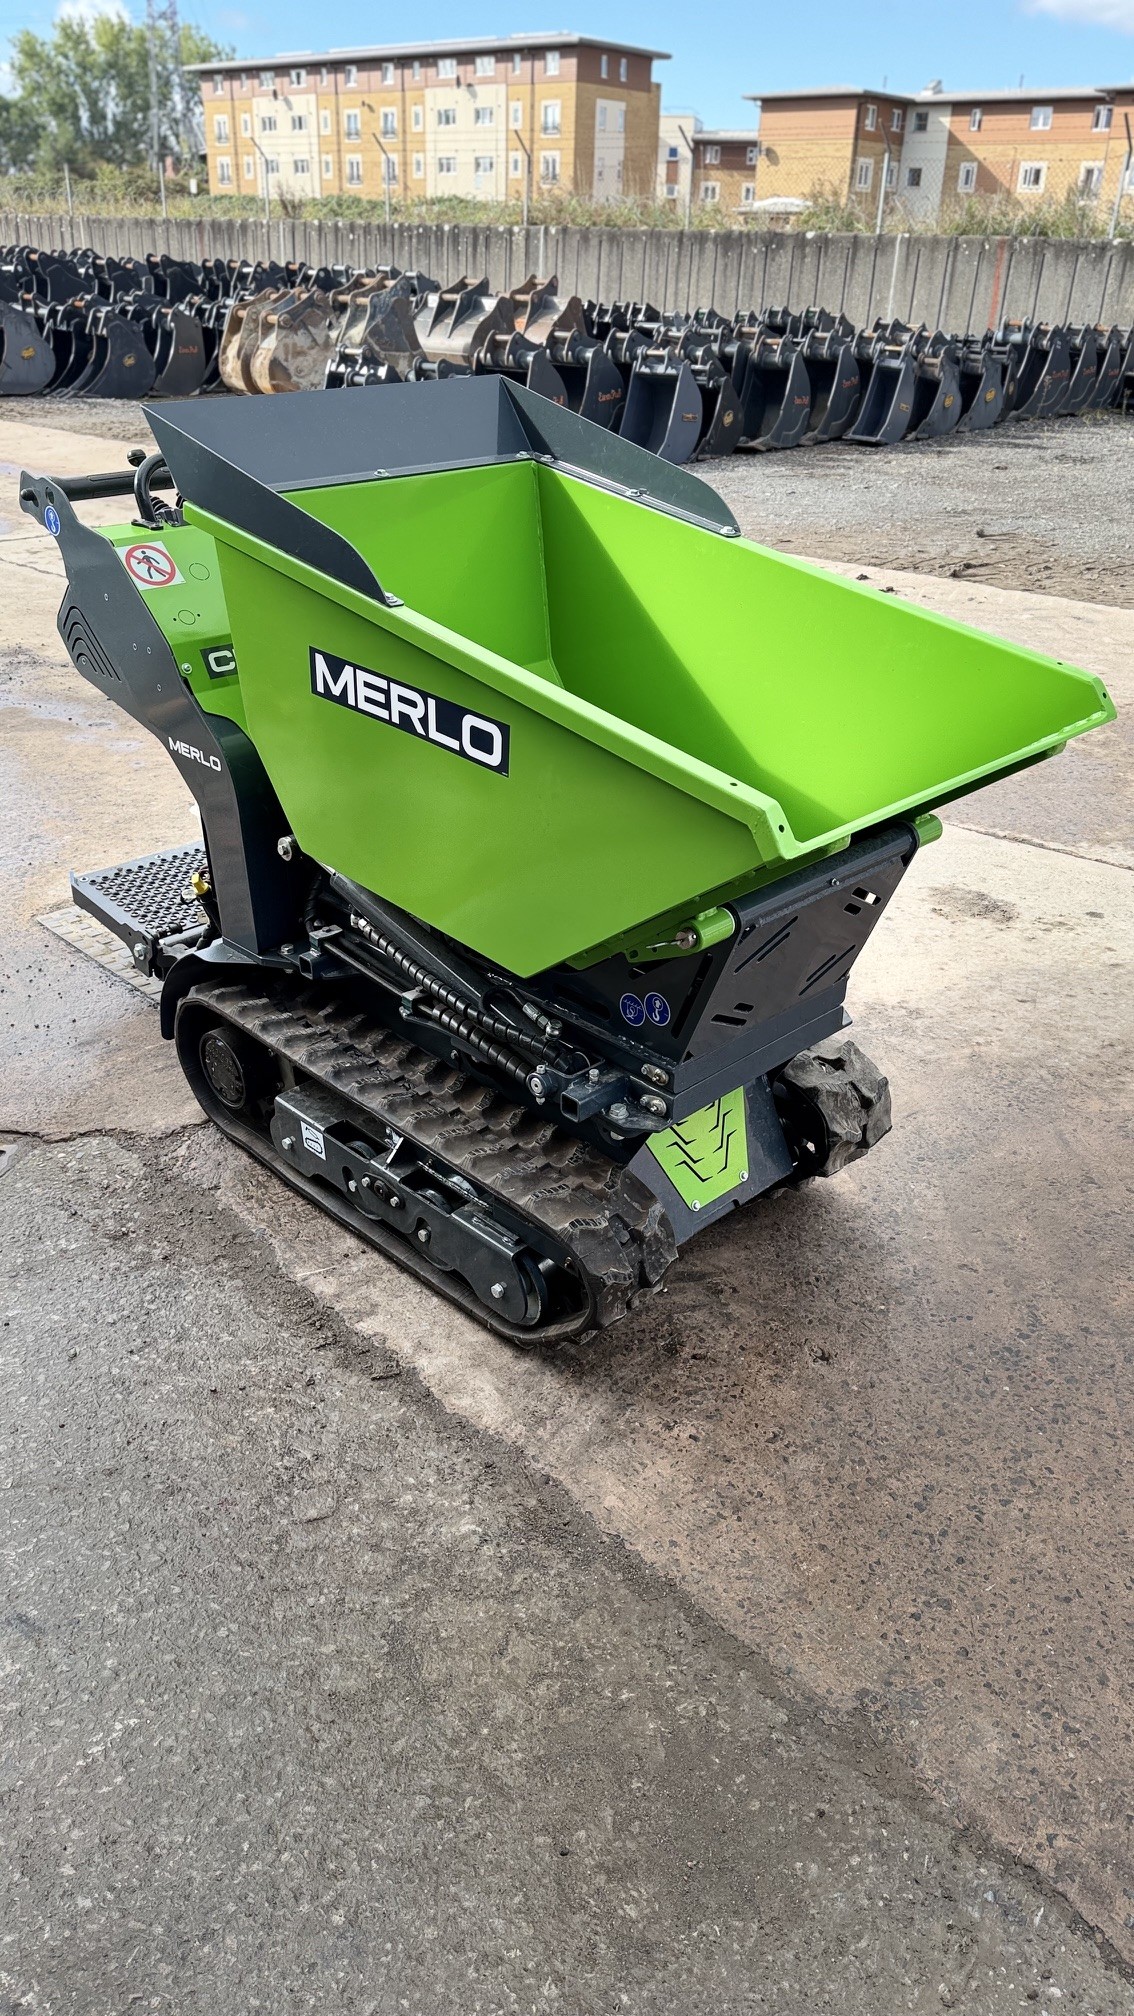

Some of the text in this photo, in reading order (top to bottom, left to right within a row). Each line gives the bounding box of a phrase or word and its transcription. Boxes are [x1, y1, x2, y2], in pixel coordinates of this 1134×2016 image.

[208, 649, 236, 673] C
[314, 652, 503, 767] MERLO
[168, 736, 222, 772] MERLO
